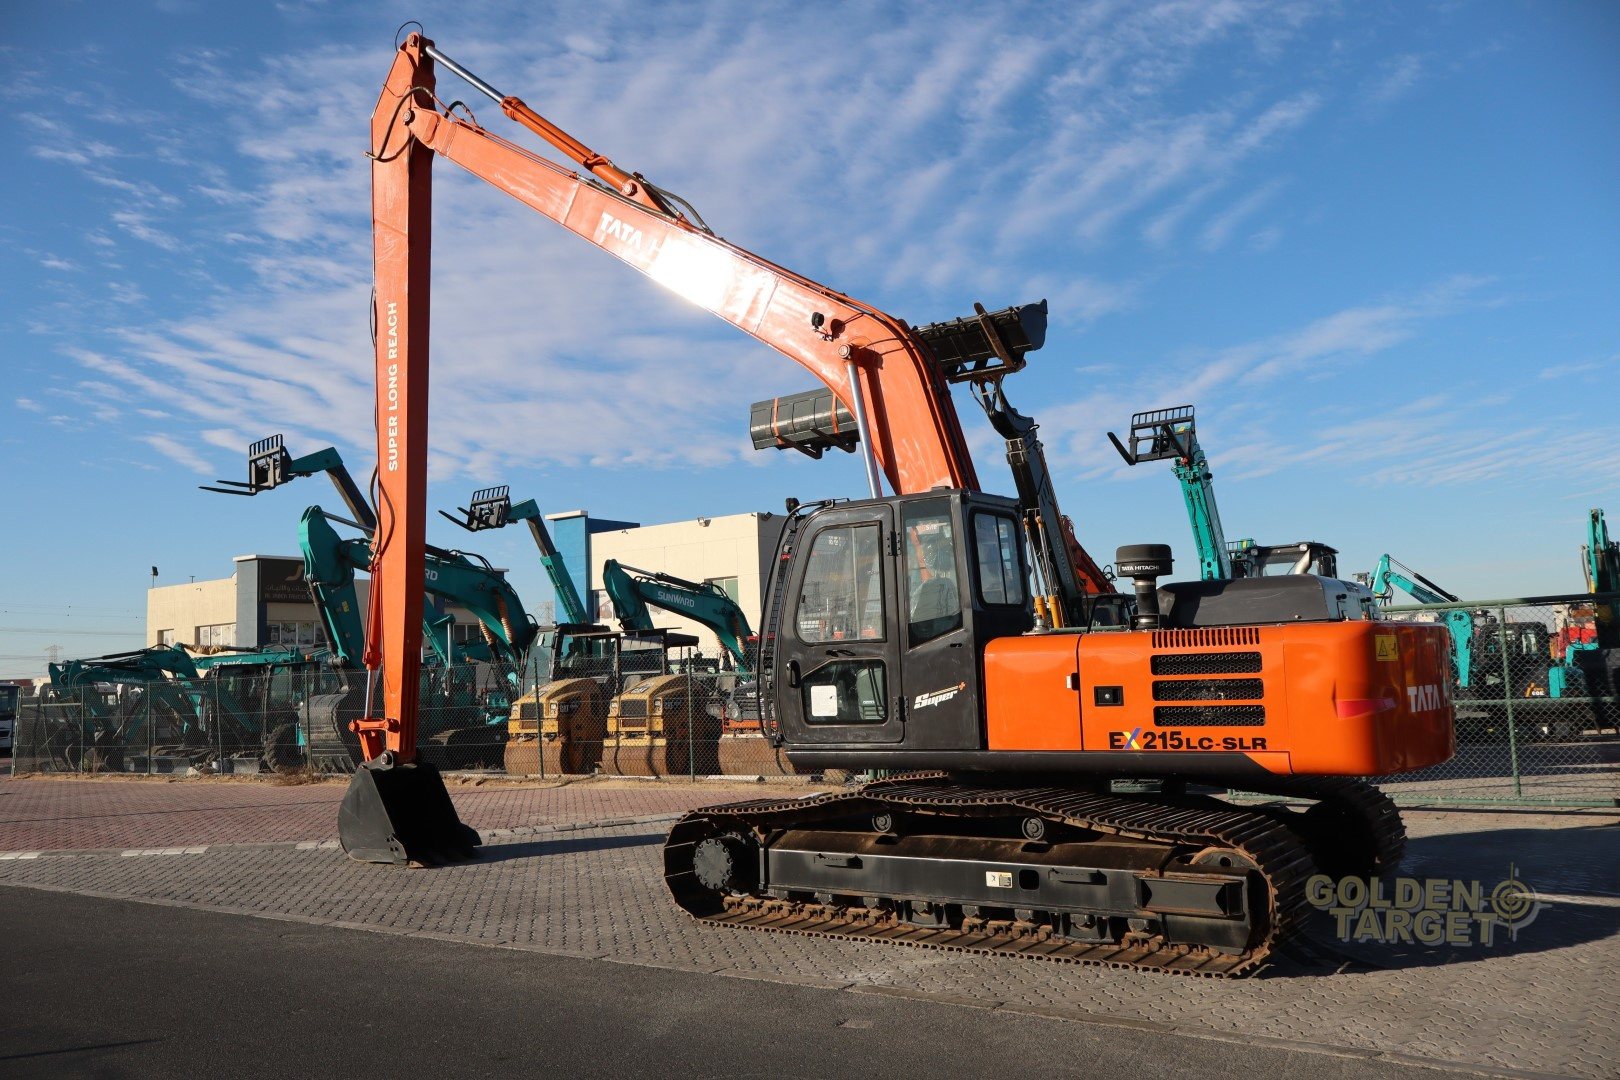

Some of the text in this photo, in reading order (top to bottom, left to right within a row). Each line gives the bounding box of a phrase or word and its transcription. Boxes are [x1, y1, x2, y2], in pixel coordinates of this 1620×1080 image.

[600, 211, 643, 249] TATA
[388, 302, 398, 471] SUPER LONG REACH
[657, 591, 695, 608] SUNWARD
[1406, 684, 1441, 713] TATA
